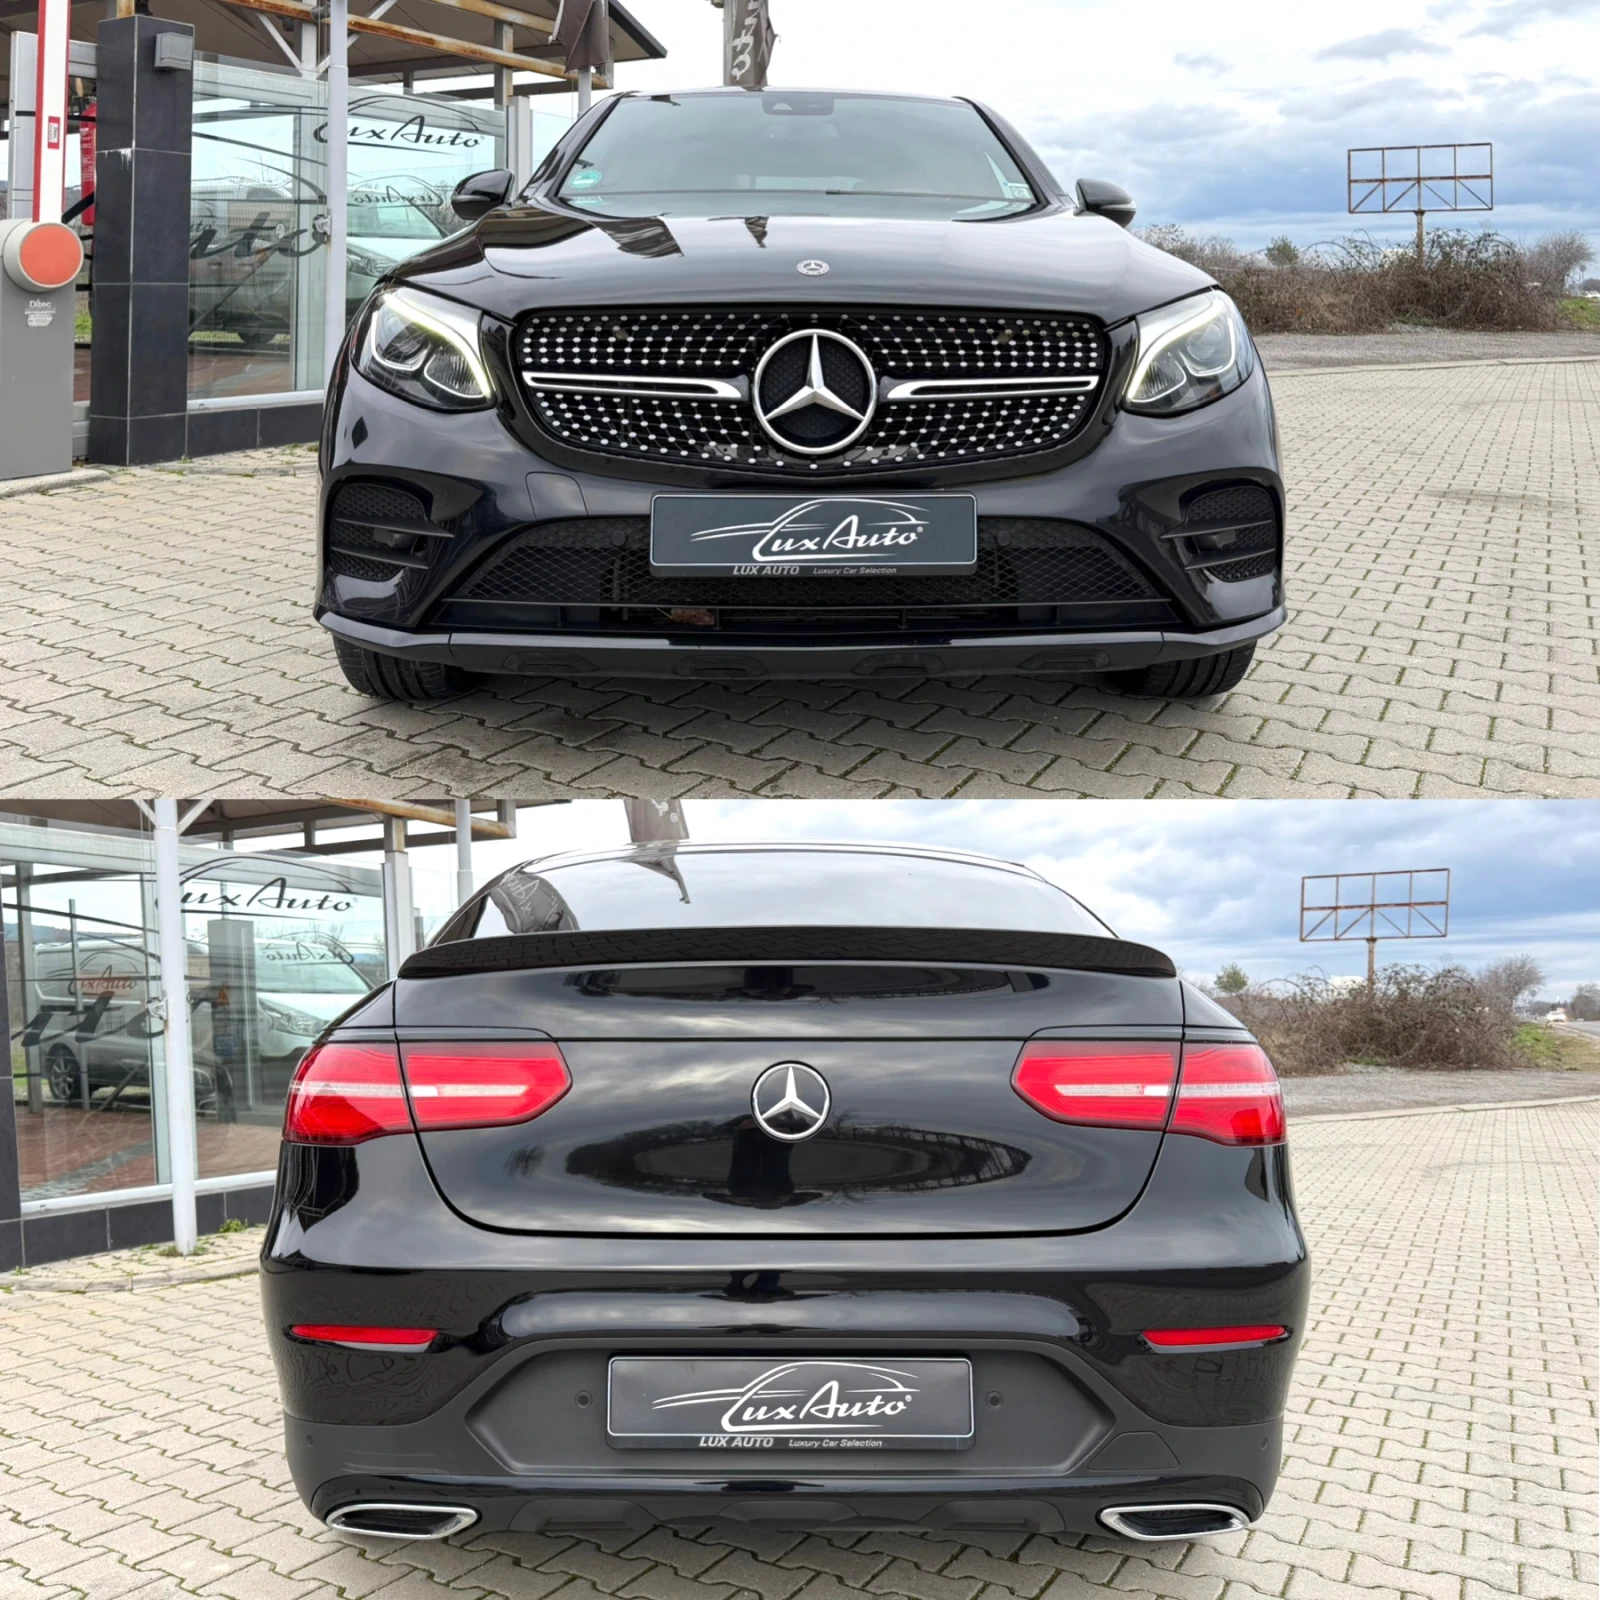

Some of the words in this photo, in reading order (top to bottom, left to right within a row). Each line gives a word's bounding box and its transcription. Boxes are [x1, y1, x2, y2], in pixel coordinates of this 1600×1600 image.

[732, 565, 758, 575] LUX
[761, 565, 800, 575] AUTO
[813, 567, 841, 576] Luxury
[843, 567, 859, 575] Car
[859, 566, 897, 575] Selection
[699, 1437, 729, 1447] LUX
[731, 1437, 774, 1447] AUTO
[788, 1439, 820, 1449] Luxury
[822, 1439, 839, 1447] Car
[839, 1439, 883, 1448] Selection
